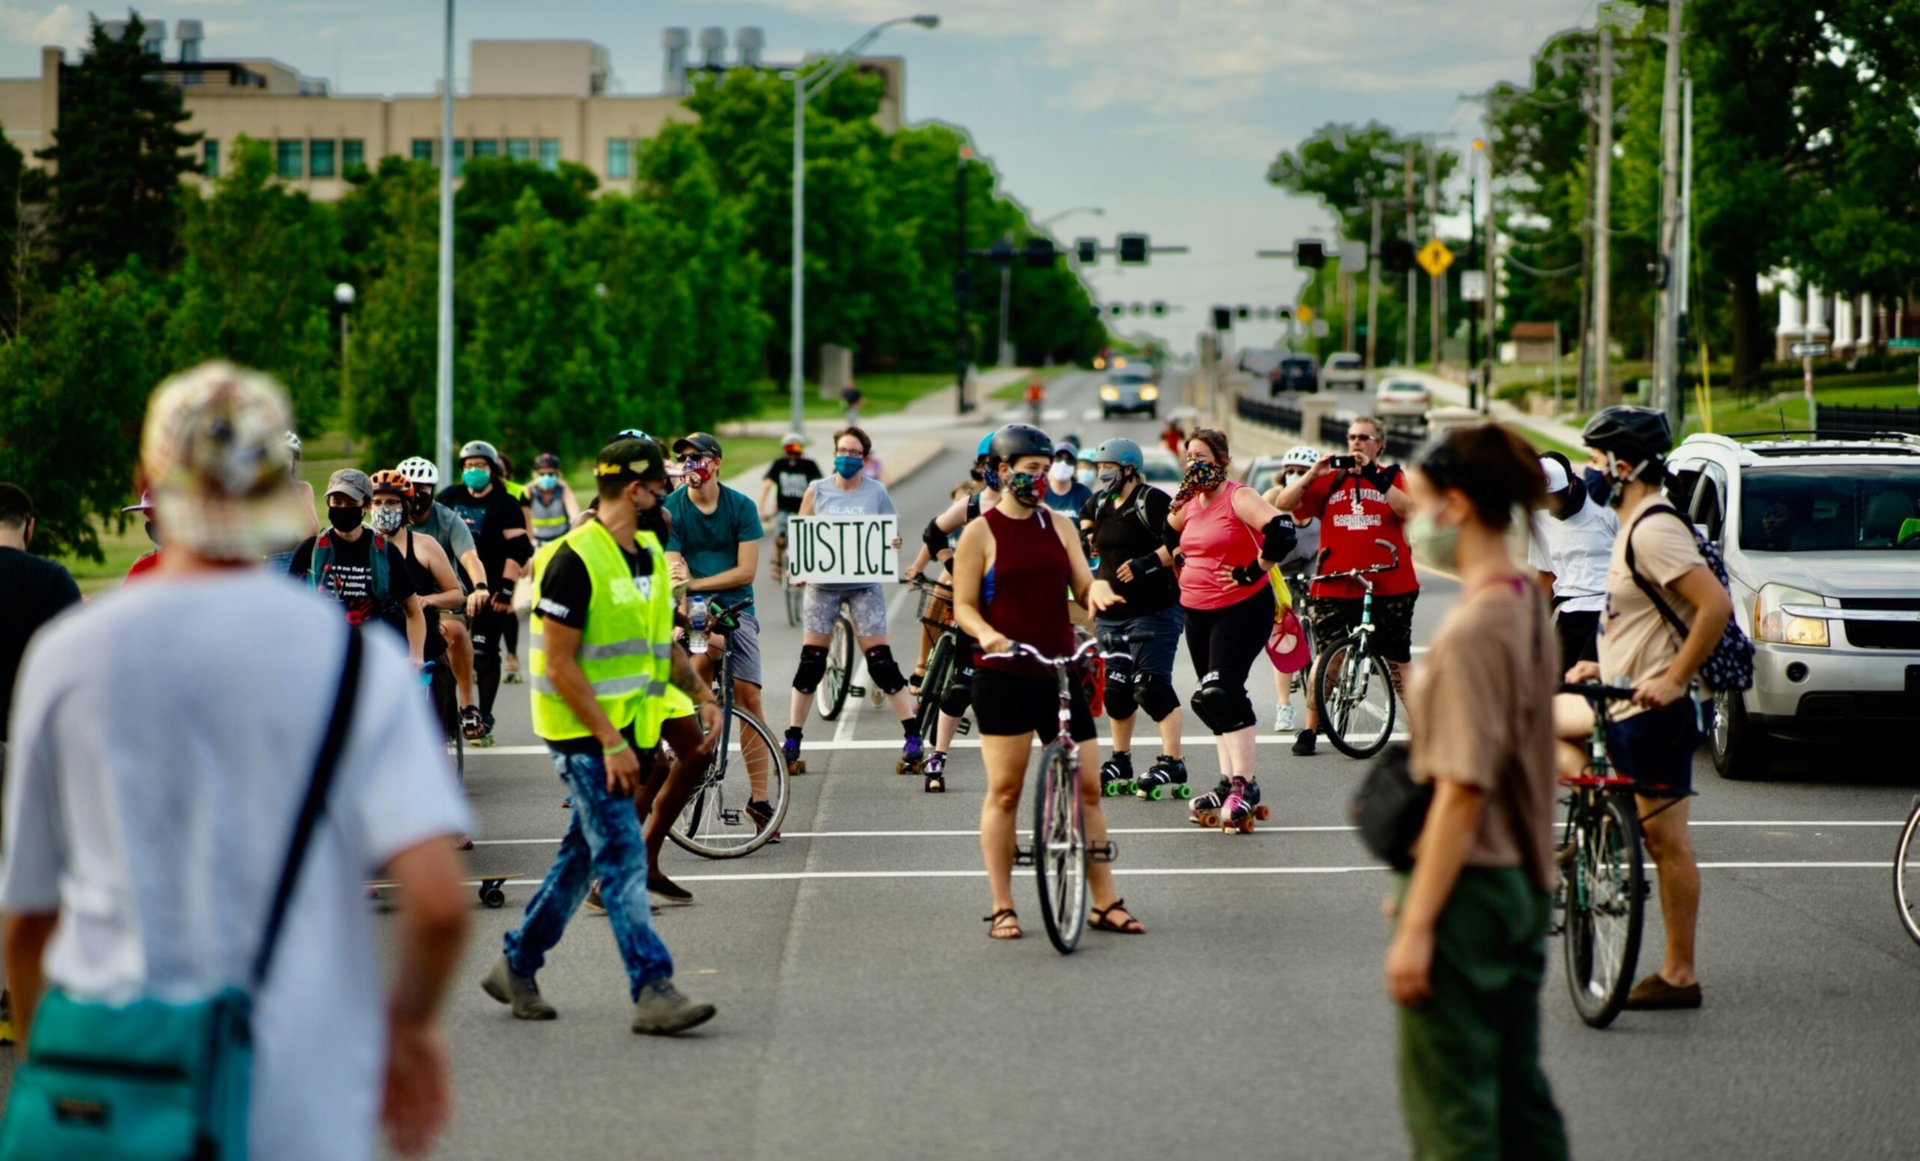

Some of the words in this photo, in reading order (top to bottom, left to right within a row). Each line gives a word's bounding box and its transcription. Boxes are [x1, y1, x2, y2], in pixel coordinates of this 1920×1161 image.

[1333, 514, 1382, 527] CARDINALS
[790, 519, 894, 577] JUSTICE
[345, 581, 366, 589] killing
